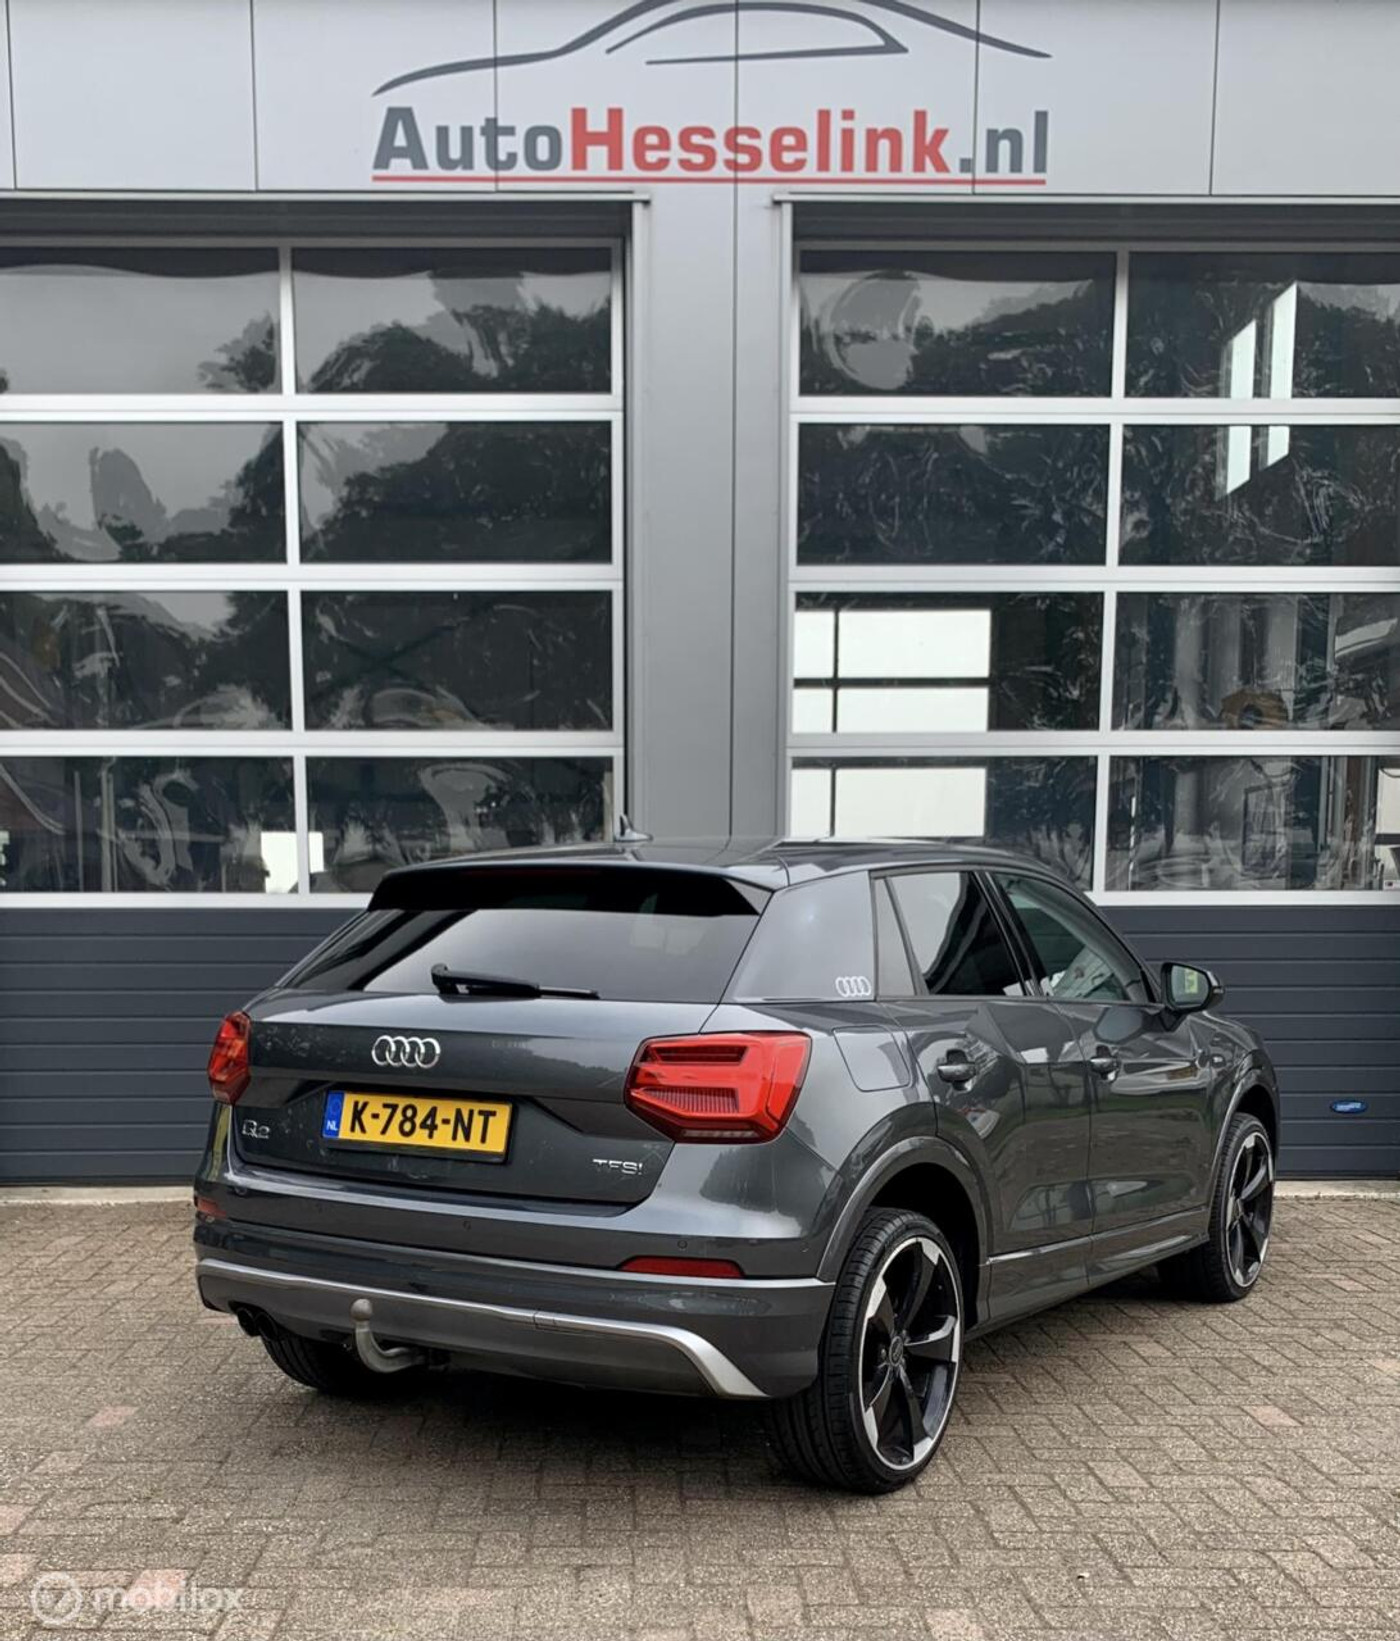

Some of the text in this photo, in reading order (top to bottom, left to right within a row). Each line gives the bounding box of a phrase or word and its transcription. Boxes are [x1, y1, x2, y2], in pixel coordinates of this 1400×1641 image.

[372, 106, 1049, 174] AutoHesselink.nl
[326, 1120, 339, 1131] NL
[350, 1100, 497, 1145] K-784-NT
